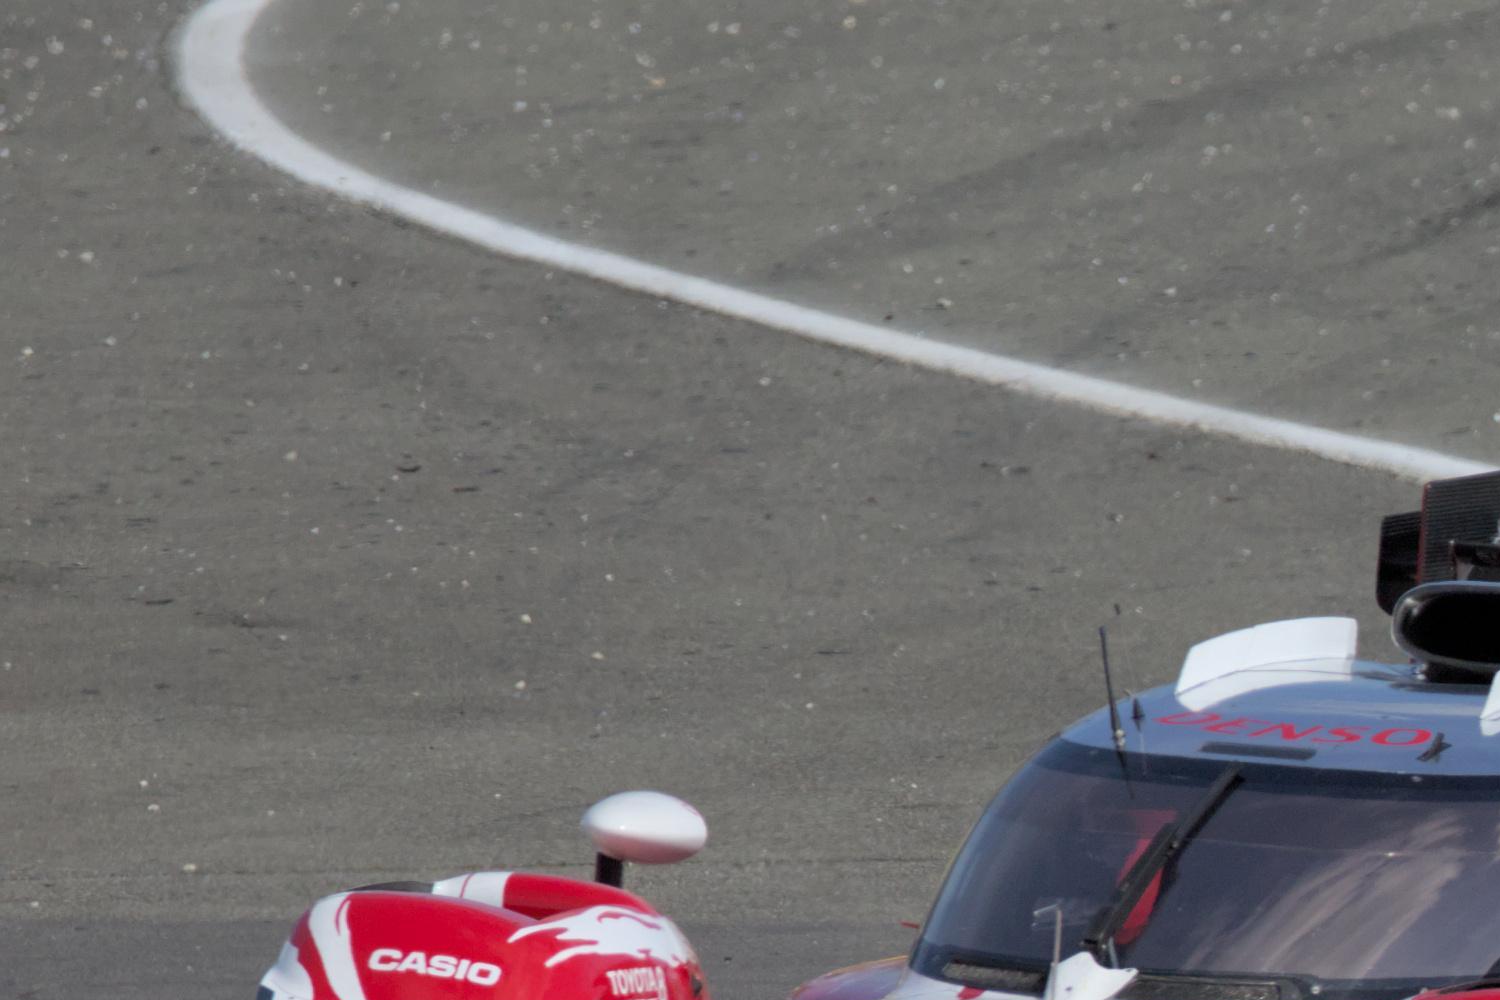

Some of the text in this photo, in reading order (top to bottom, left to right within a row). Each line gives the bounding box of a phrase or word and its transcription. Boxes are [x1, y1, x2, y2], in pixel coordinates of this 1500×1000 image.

[1155, 710, 1433, 747] DENSO
[368, 947, 502, 987] CASIO
[606, 966, 658, 995] TOYOTA
